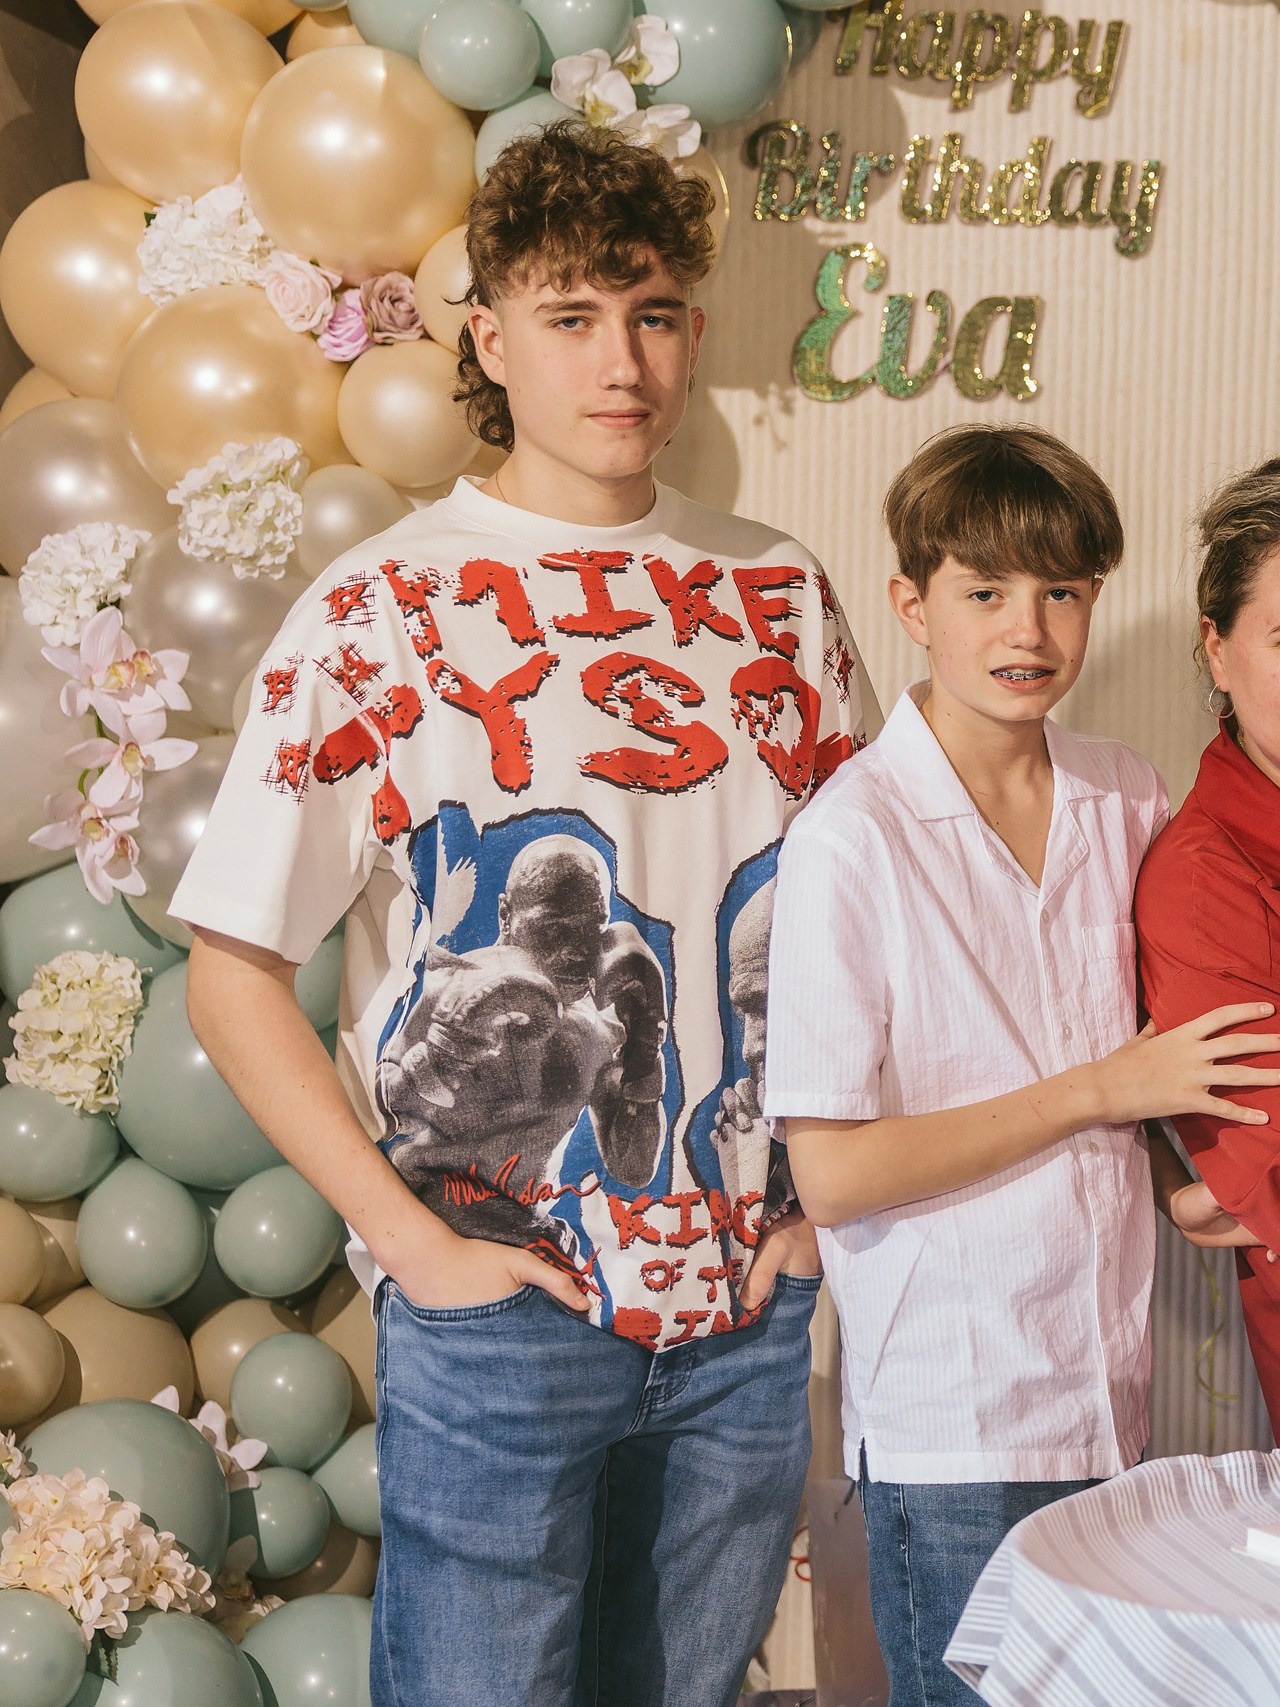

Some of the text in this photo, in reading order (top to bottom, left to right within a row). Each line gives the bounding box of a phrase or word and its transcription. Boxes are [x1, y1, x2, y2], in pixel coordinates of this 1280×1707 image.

[828, 0, 1124, 118] Happy
[742, 120, 1161, 258] Birthday
[792, 243, 1041, 401] Eva
[380, 547, 807, 661] MIKE
[639, 1258, 687, 1292] OF
